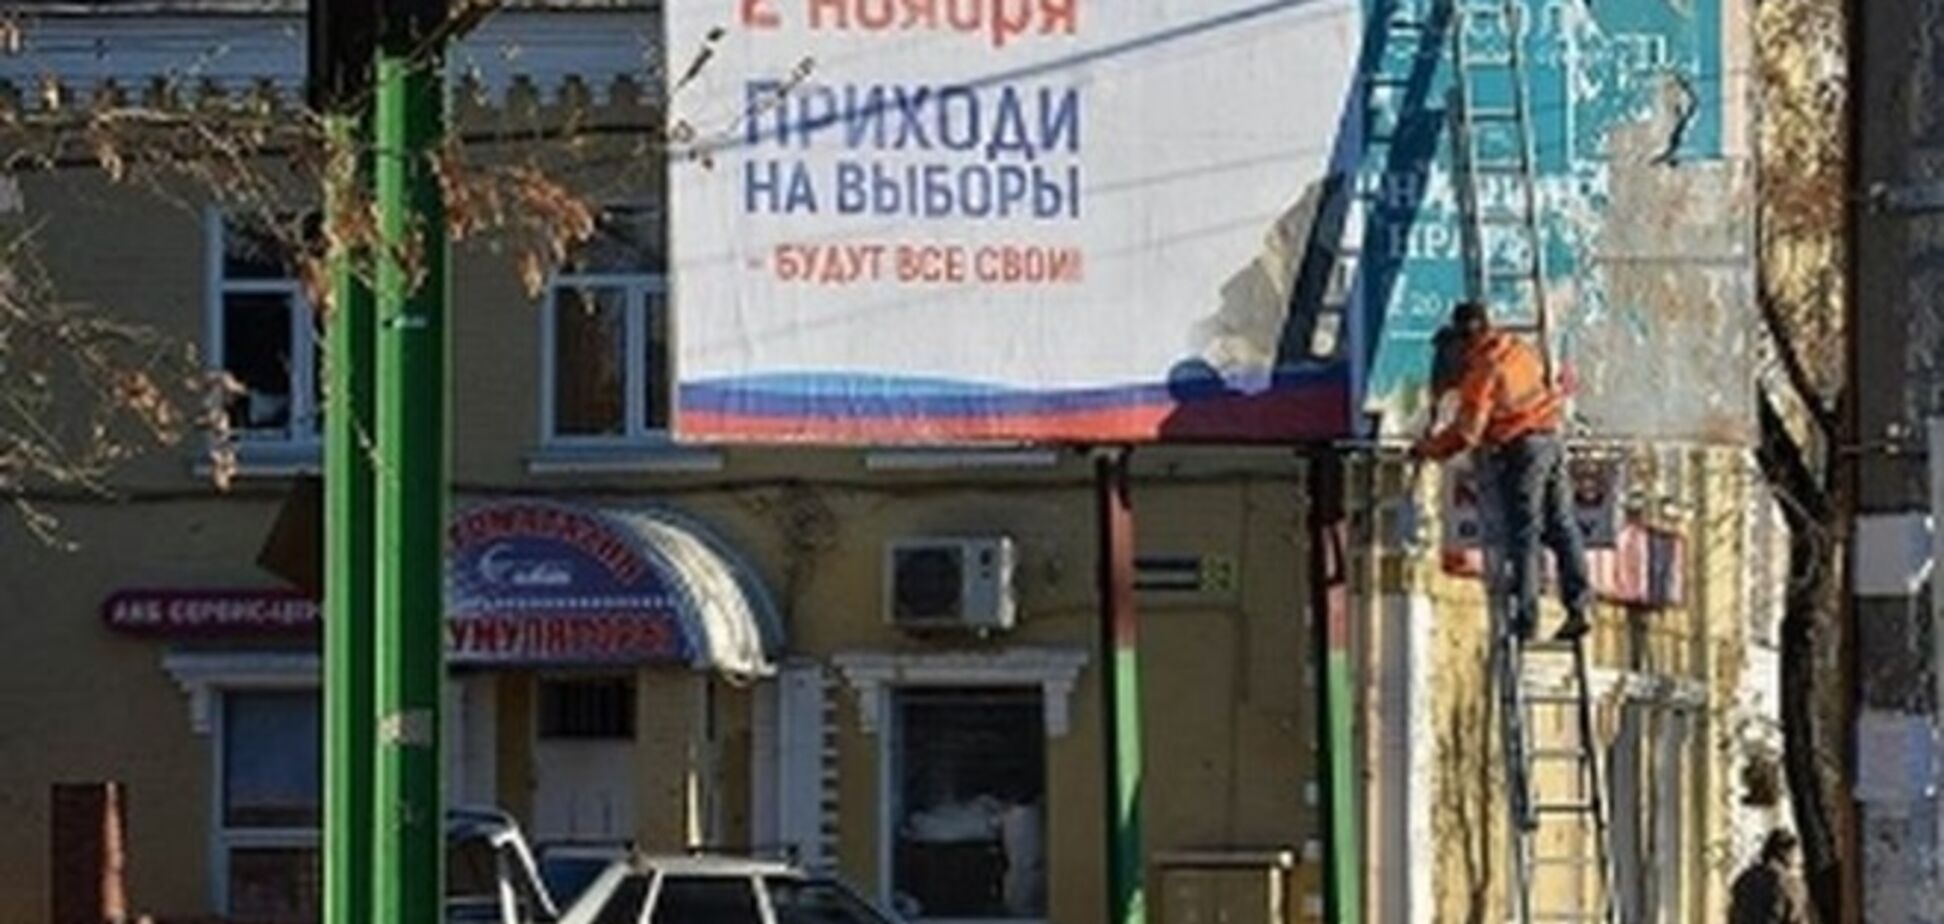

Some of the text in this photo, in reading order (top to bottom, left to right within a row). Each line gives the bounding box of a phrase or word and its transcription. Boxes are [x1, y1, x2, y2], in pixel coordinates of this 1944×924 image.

[745, 80, 1080, 161] ПРИХОДИ
[744, 161, 1080, 219] НА ВЫБОРЫ
[775, 246, 884, 283] БУДУТ
[897, 247, 965, 282] ВСЕ
